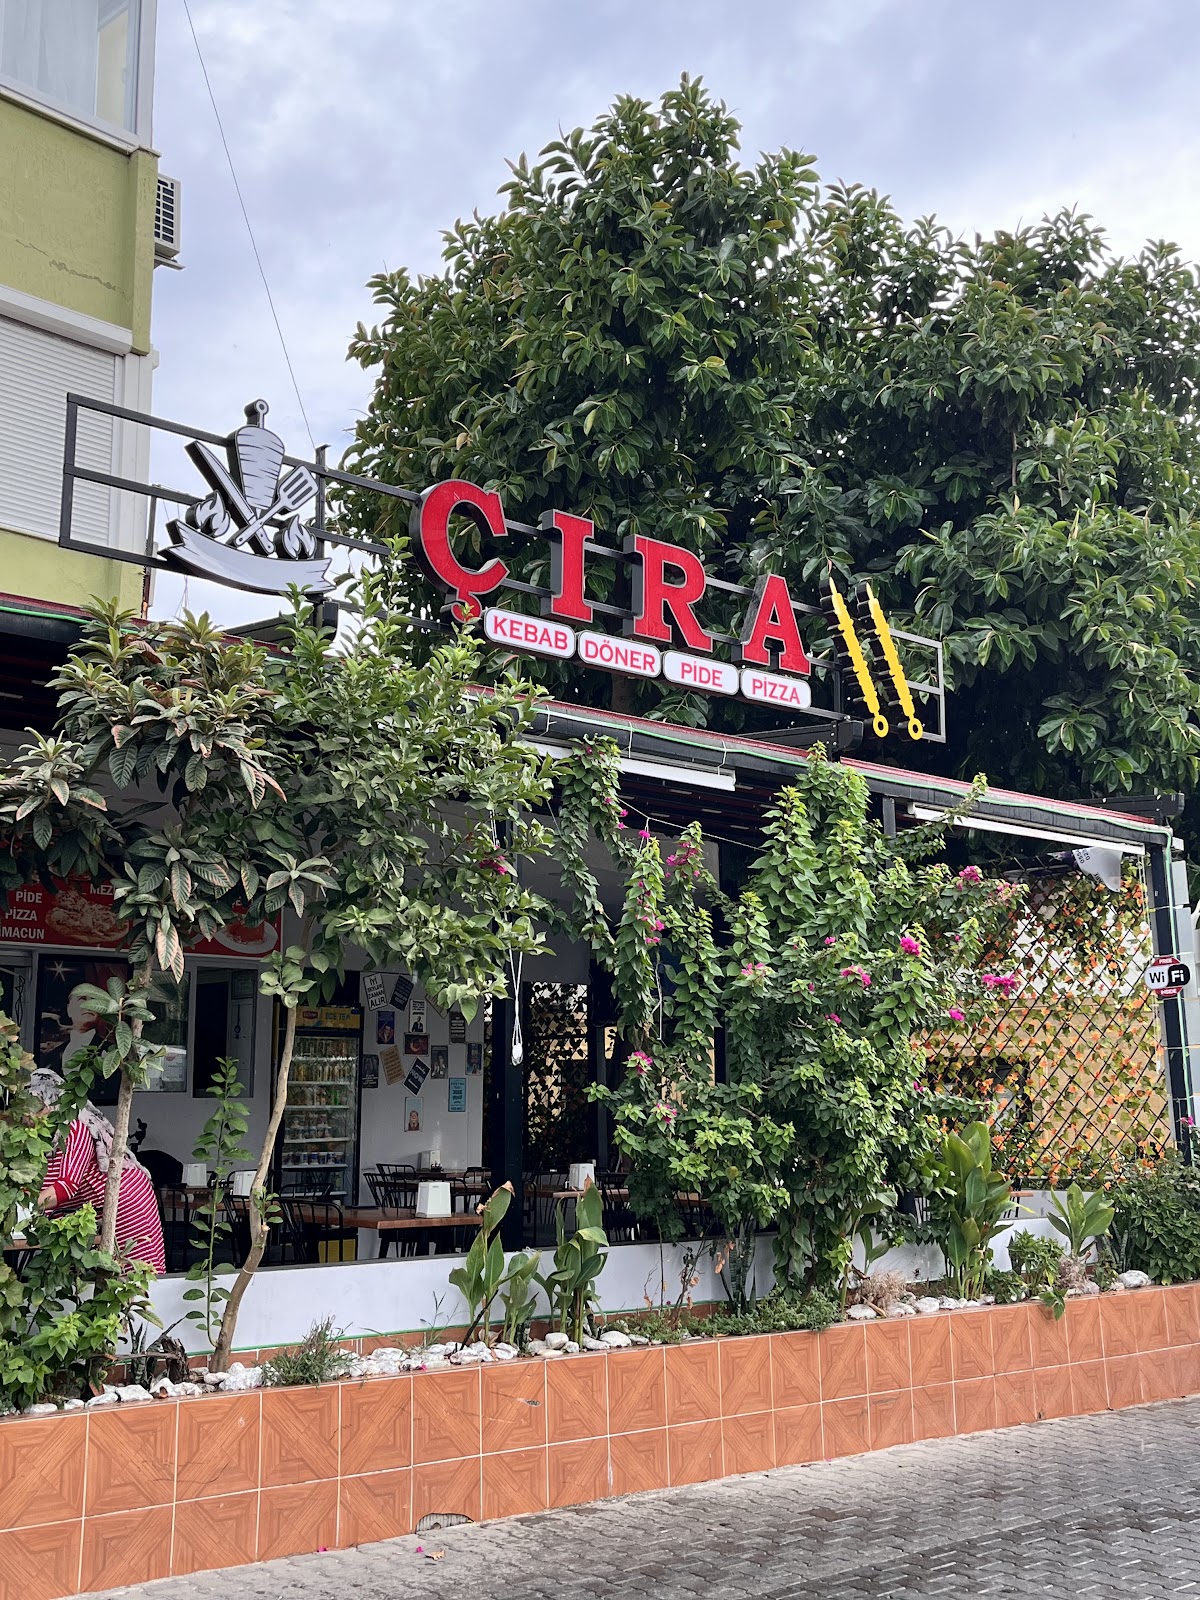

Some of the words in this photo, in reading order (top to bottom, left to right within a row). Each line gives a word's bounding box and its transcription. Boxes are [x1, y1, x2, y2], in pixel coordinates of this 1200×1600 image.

[416, 479, 812, 676] ÇIRA
[493, 615, 568, 650] KEBAB
[585, 639, 656, 673] DÖNER
[680, 660, 723, 688] PİDE
[752, 677, 801, 704] PİZZA
[16, 889, 43, 904] PİDE
[90, 884, 115, 896] MEZ
[5, 906, 38, 921] PİZZA
[0, 926, 45, 940] MACUN
[1149, 971, 1165, 984] Wi
[1171, 970, 1185, 983] Fi
